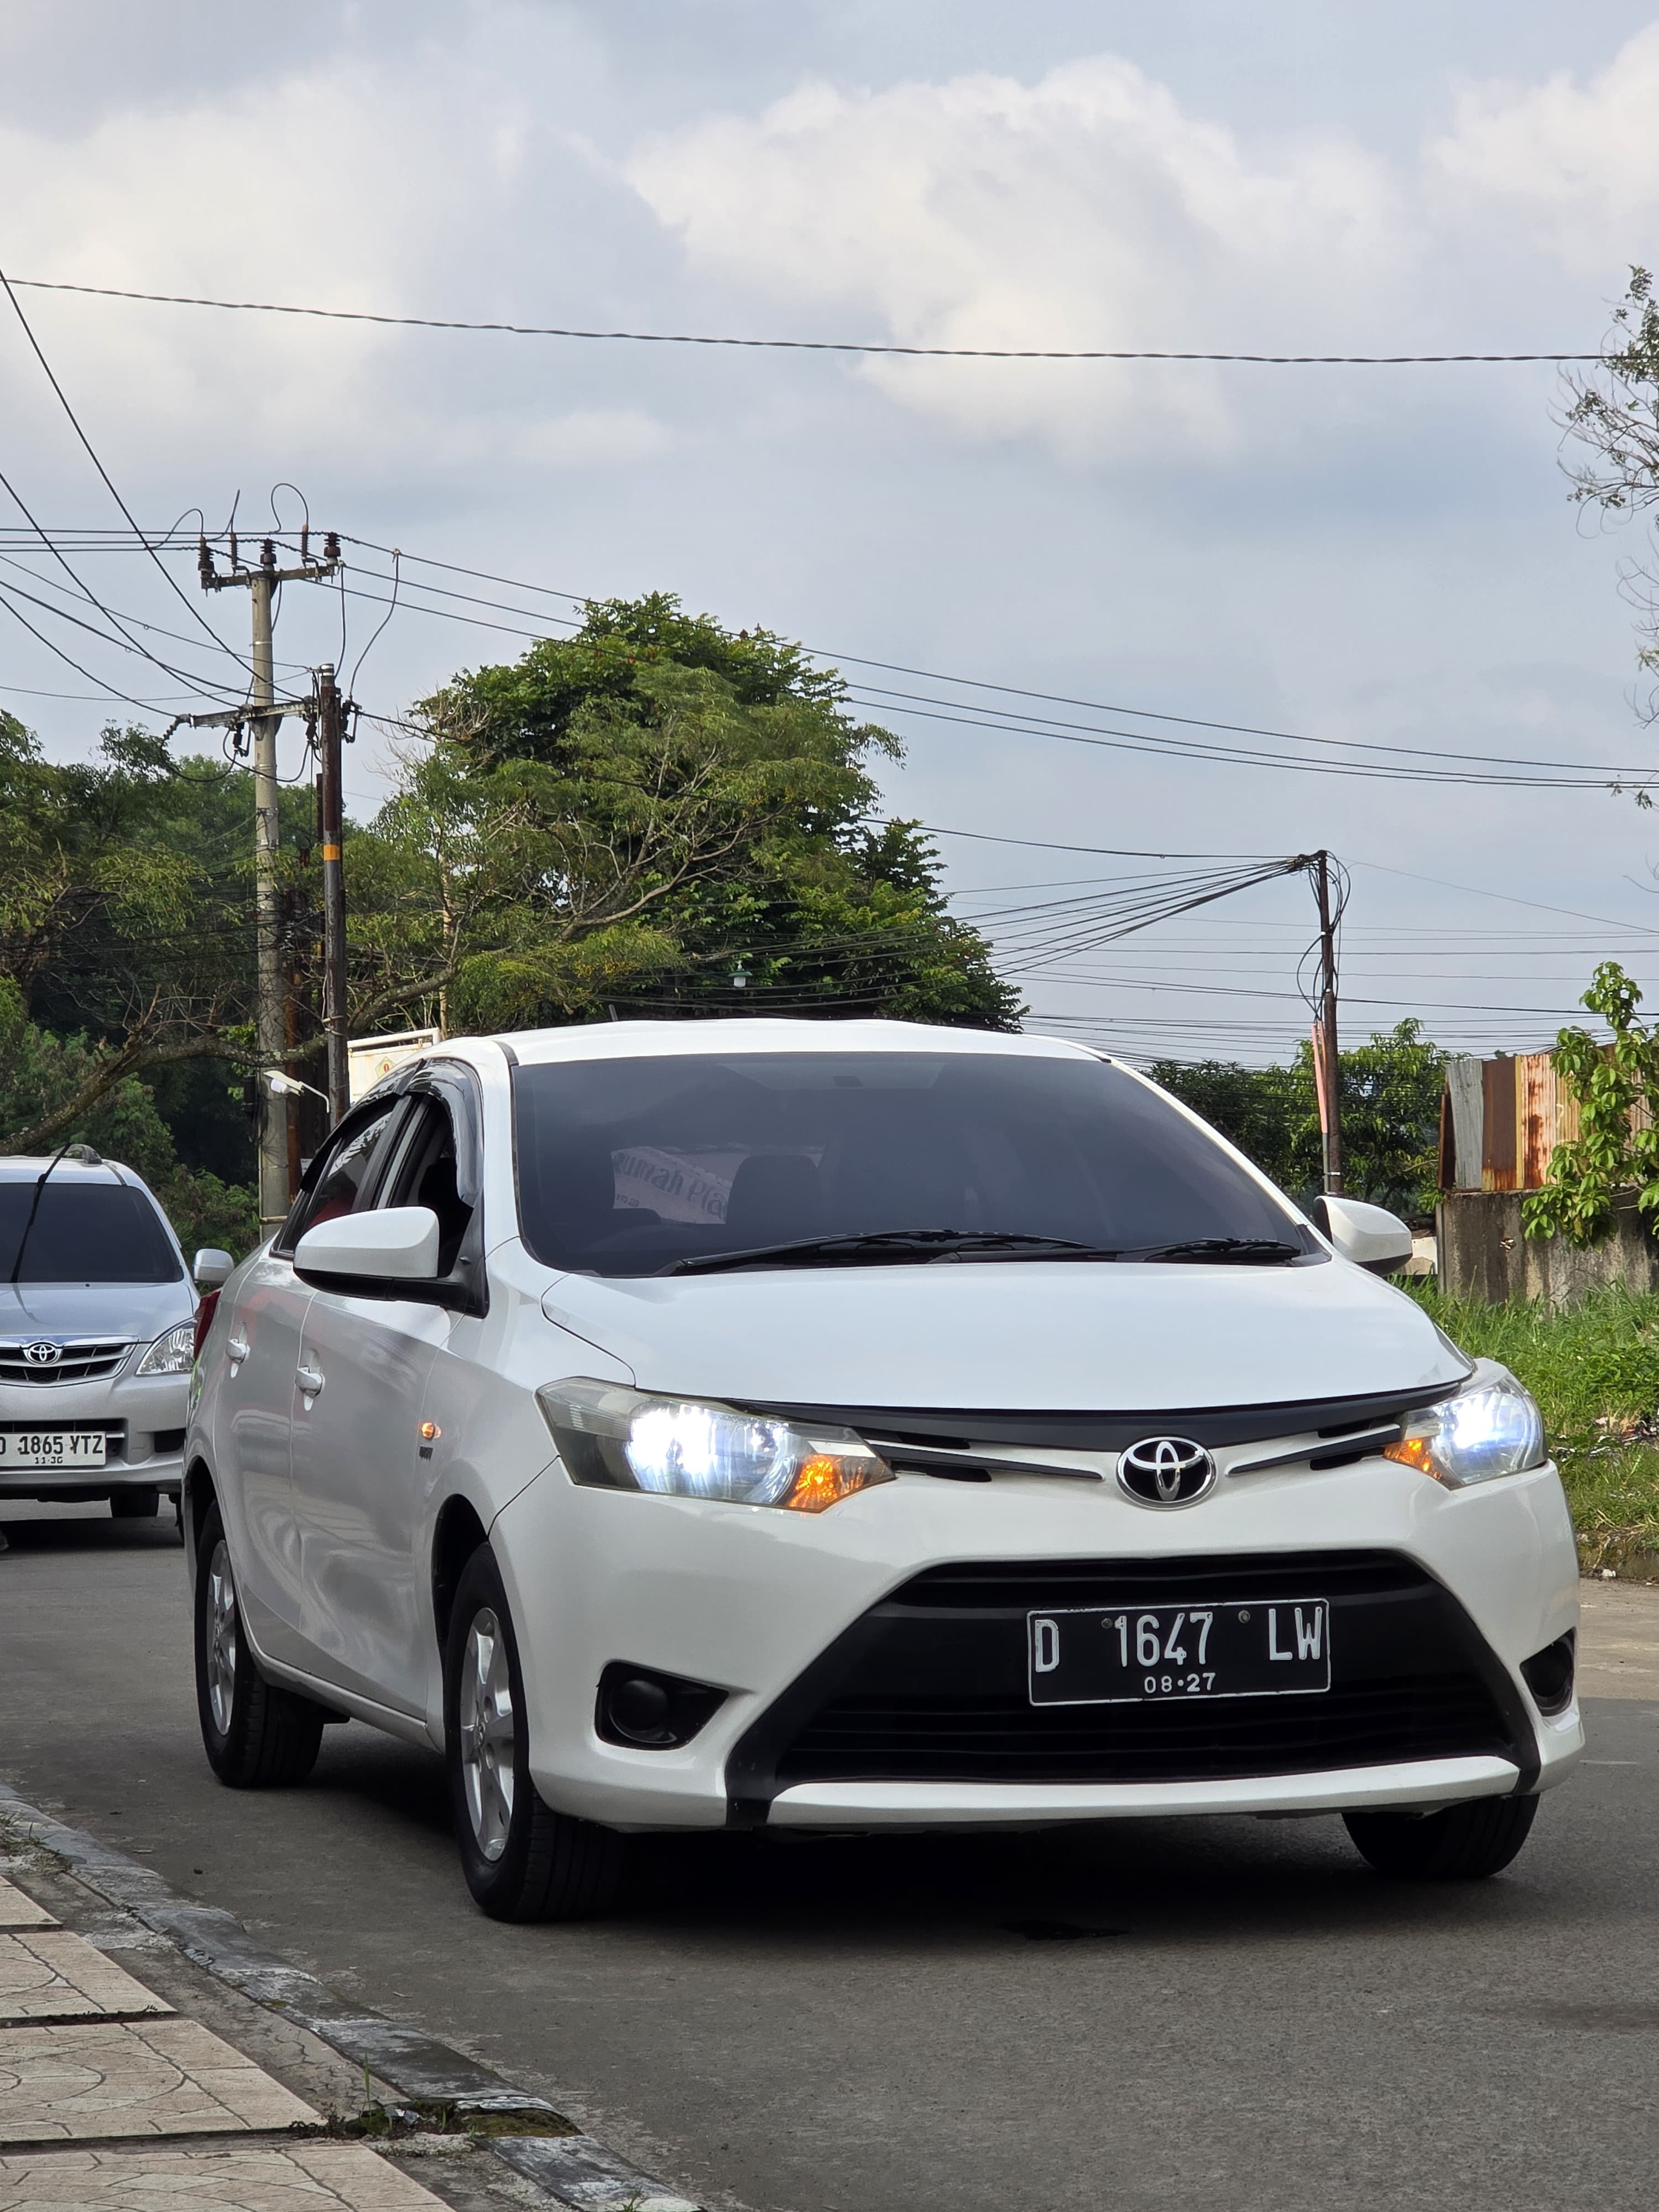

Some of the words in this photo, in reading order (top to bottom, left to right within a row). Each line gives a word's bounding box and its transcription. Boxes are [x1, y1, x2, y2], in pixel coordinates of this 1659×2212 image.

[19, 1435, 63, 1454] 1865
[70, 1435, 103, 1454] YTZ
[1035, 1619, 1060, 1672] D
[1115, 1612, 1213, 1667] 1647
[1268, 1606, 1323, 1660] LW
